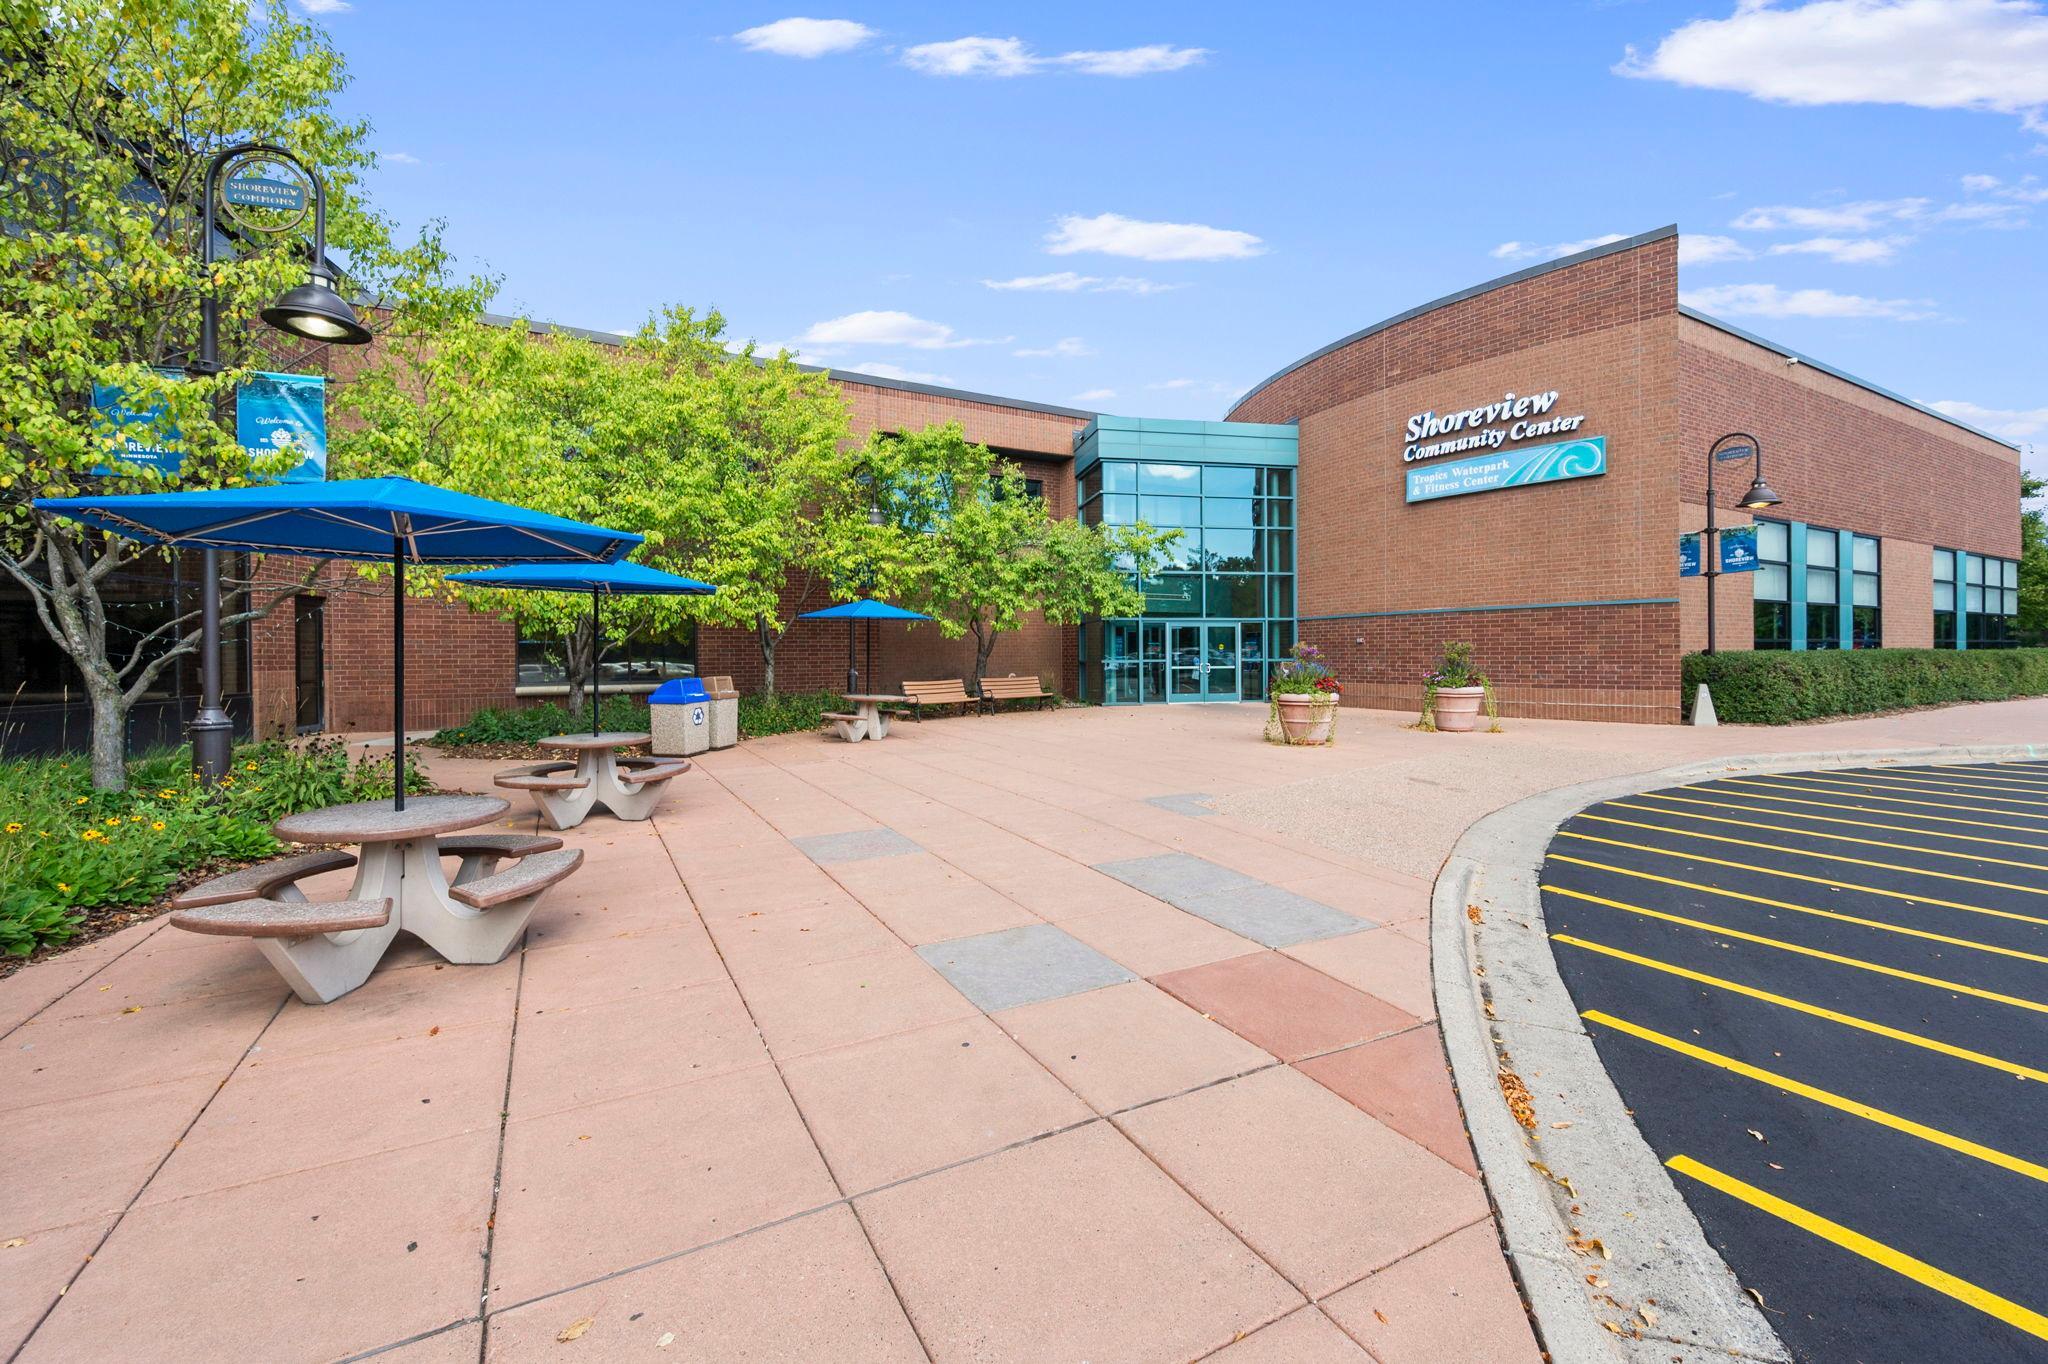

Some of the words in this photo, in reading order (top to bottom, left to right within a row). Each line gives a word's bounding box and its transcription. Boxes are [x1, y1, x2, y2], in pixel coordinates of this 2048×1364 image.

[230, 182, 299, 197] SHOREVIEW
[233, 193, 296, 206] COMMONS
[110, 408, 153, 418] Welcme
[1404, 390, 1560, 443] Shoreview
[1403, 428, 1506, 462] Community
[1510, 415, 1585, 441] Center
[1412, 471, 1448, 485] Tropics
[1452, 459, 1510, 478] Waterpark
[1412, 485, 1421, 496] &
[1425, 479, 1460, 493] Fitness
[1463, 474, 1500, 488] Center
